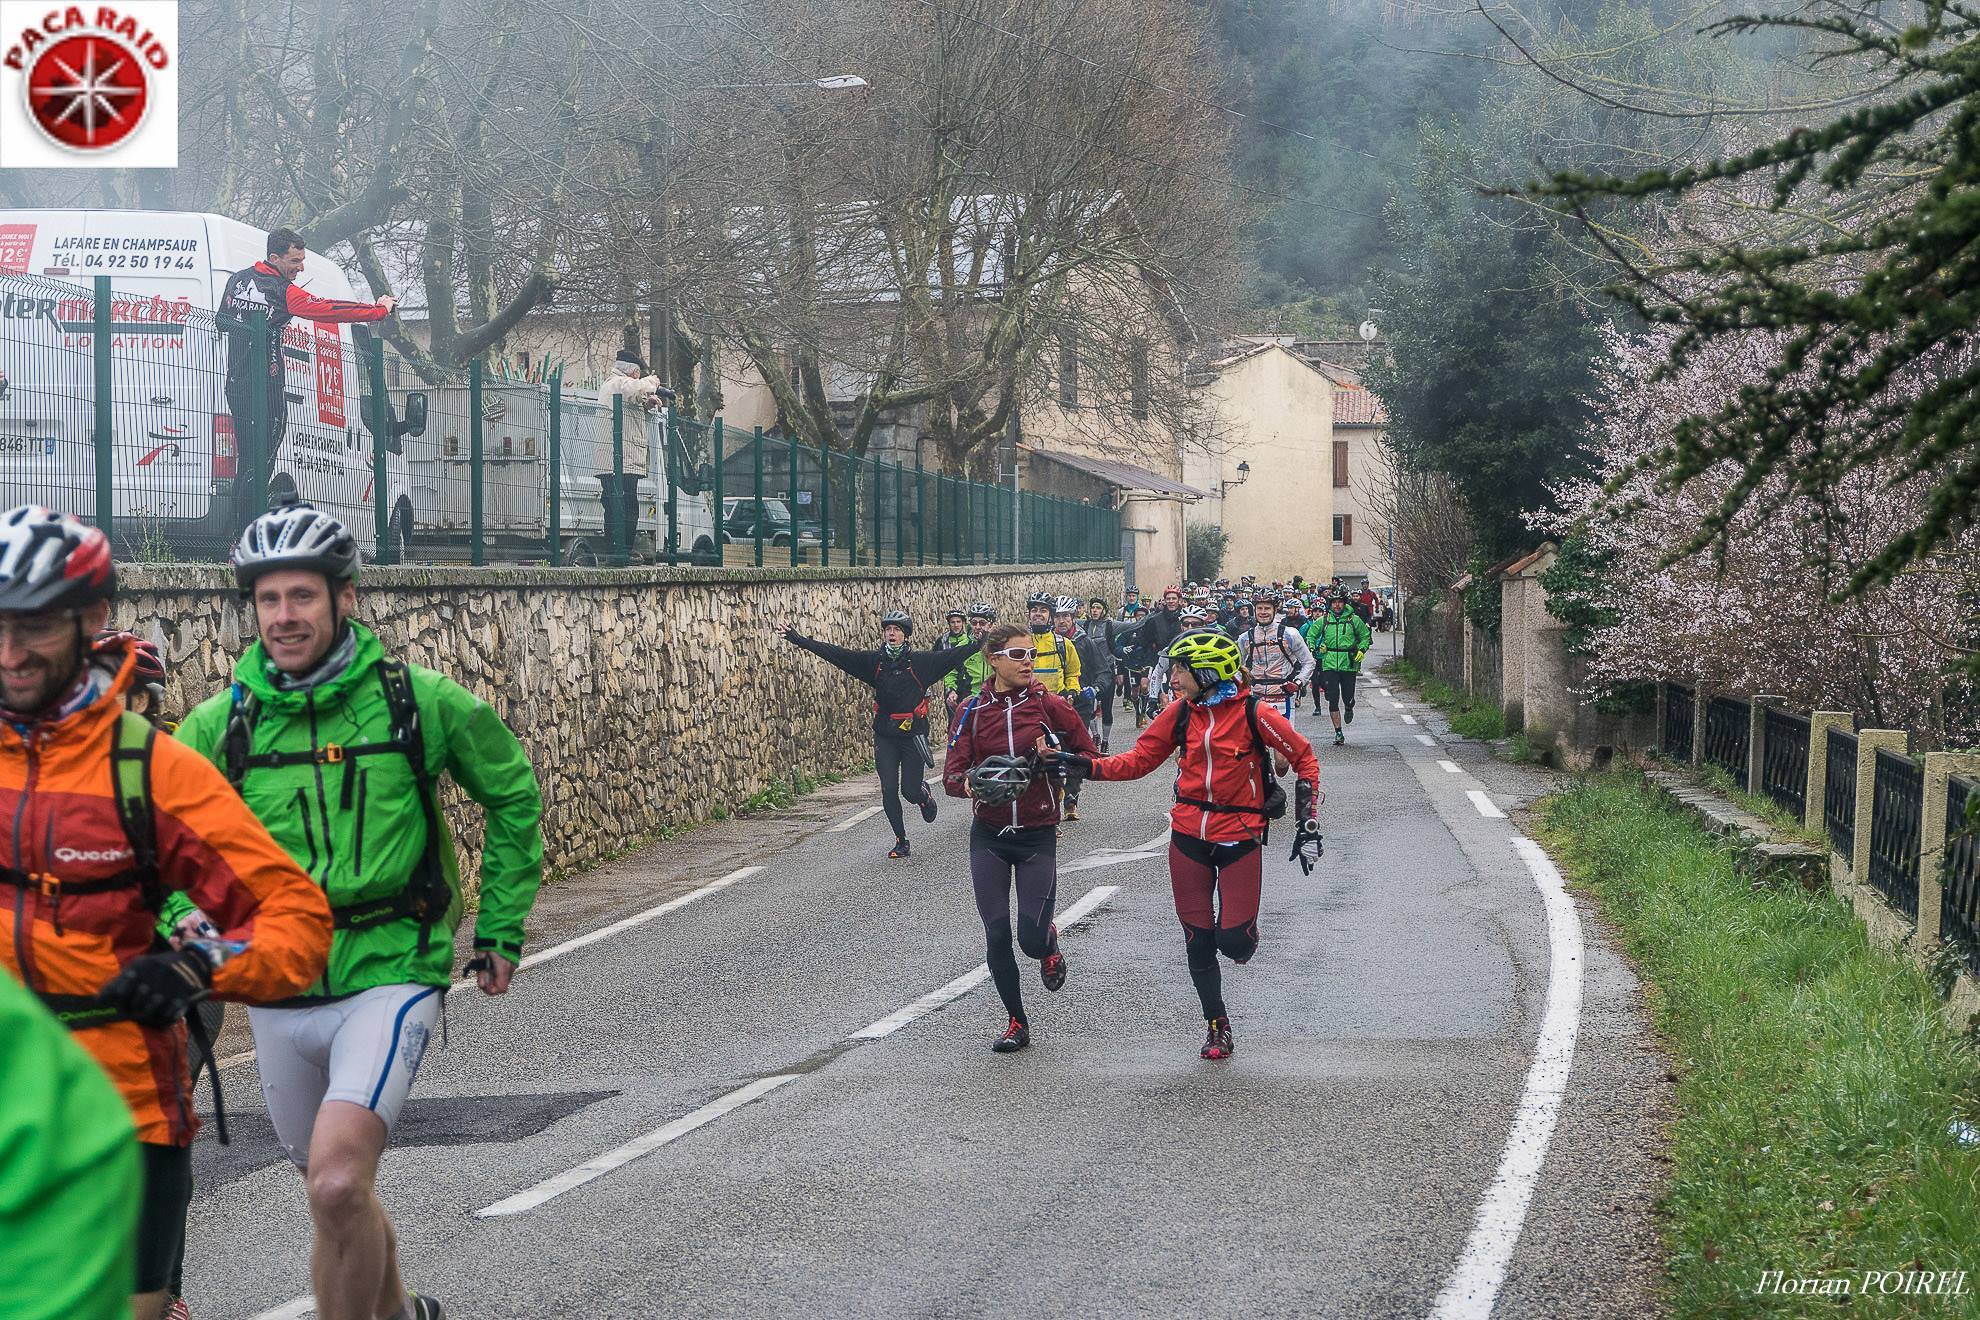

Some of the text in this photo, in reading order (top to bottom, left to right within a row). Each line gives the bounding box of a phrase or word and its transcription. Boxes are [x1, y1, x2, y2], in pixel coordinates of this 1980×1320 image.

[54, 237, 197, 251] LAFARE EN CHAMPSAUR
[52, 252, 194, 270] Tél. 04 92 50 19 44
[64, 335, 185, 350] LOATION
